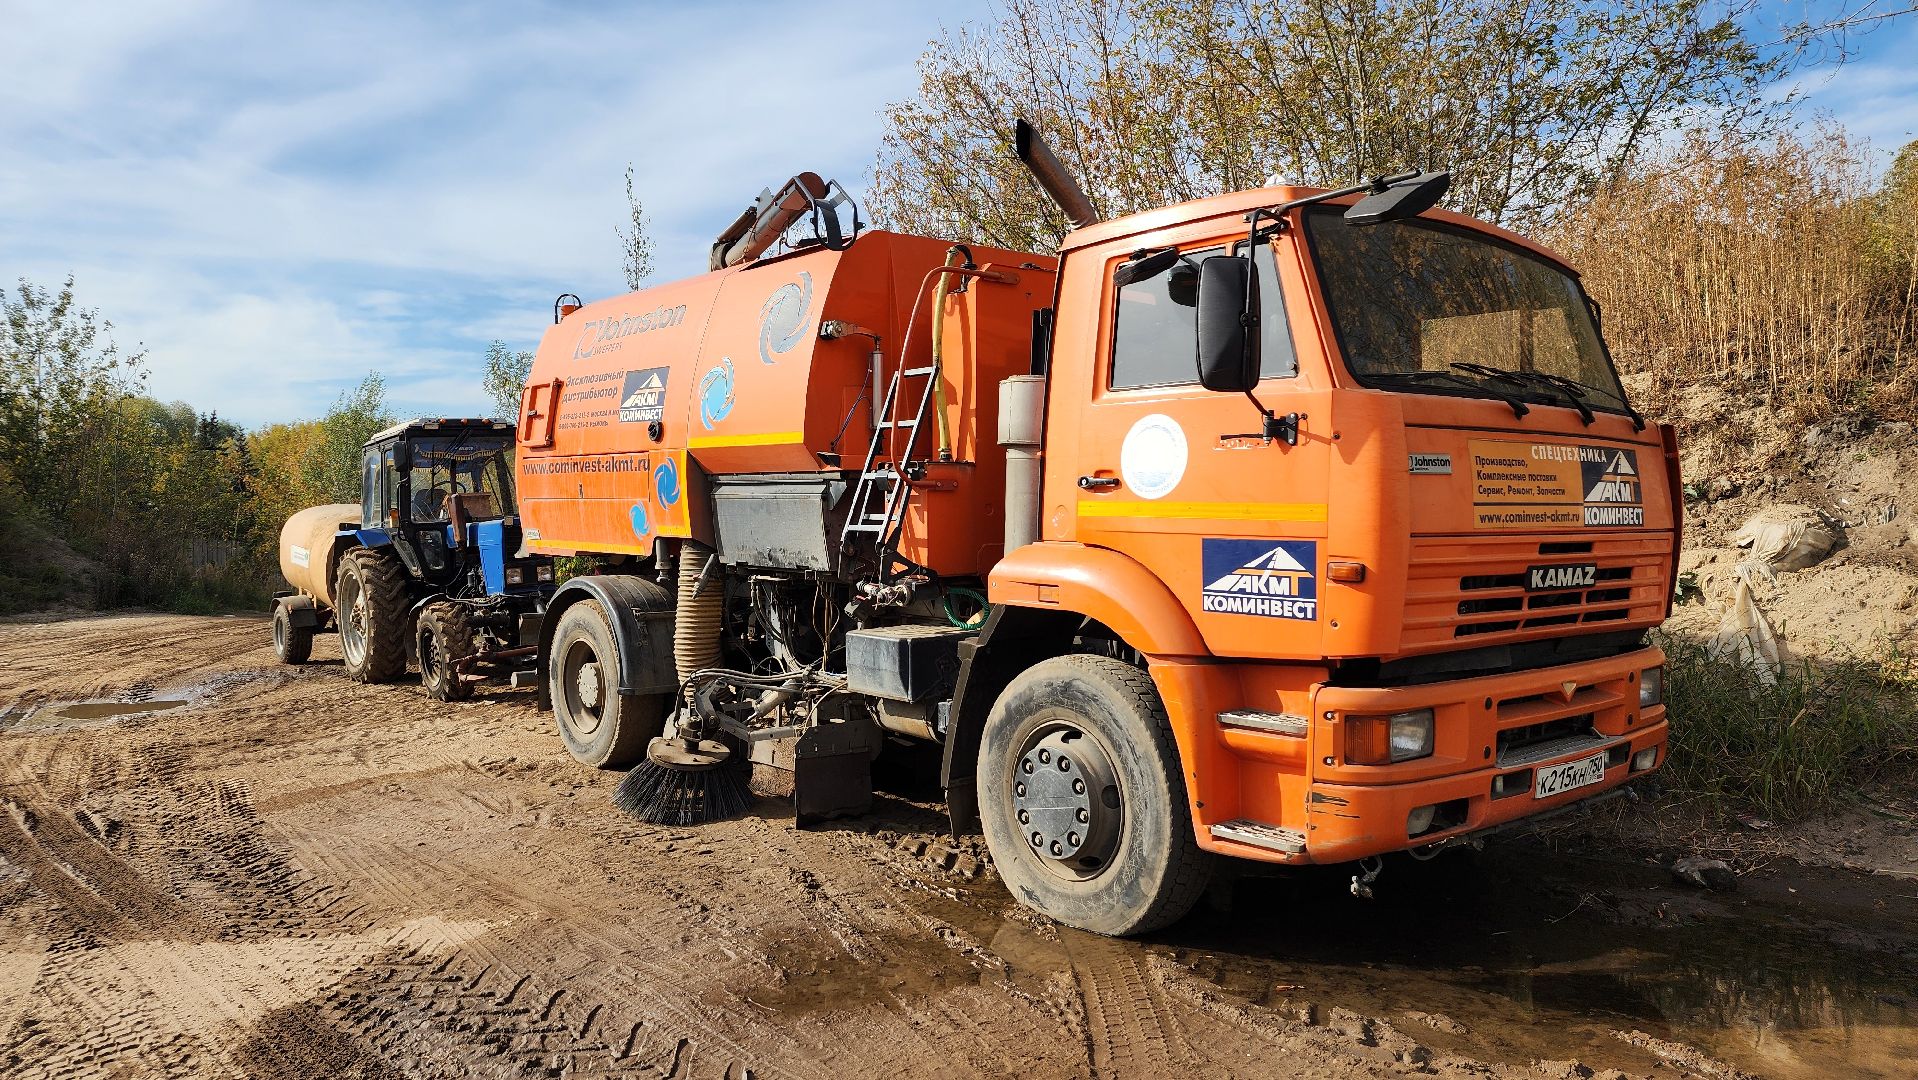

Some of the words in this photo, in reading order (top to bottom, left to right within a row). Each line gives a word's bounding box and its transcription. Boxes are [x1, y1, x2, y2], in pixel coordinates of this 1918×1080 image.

[598, 304, 687, 342] Johnston
[620, 408, 663, 422] КОМИНВЕСТ
[1414, 455, 1451, 467] Johnston
[1475, 455, 1528, 469] Производство,
[1532, 445, 1607, 463] СПЕЦТЕХНИКА
[523, 457, 650, 476] www.cominvest-akmt.ru
[1477, 470, 1527, 482] Комплексные
[1528, 472, 1557, 482] поставки
[1478, 485, 1506, 497] Сервис,
[1507, 486, 1535, 497] Ремонт,
[1536, 486, 1566, 496] Запчасти
[1479, 508, 1580, 524] www.cominvest-akmt.ru
[1584, 507, 1644, 526] КОМИНВЕСТ
[1229, 571, 1308, 596] АКМТ
[1531, 566, 1596, 588] KAMAZ
[1203, 596, 1315, 619] КОМИНВЕСТ
